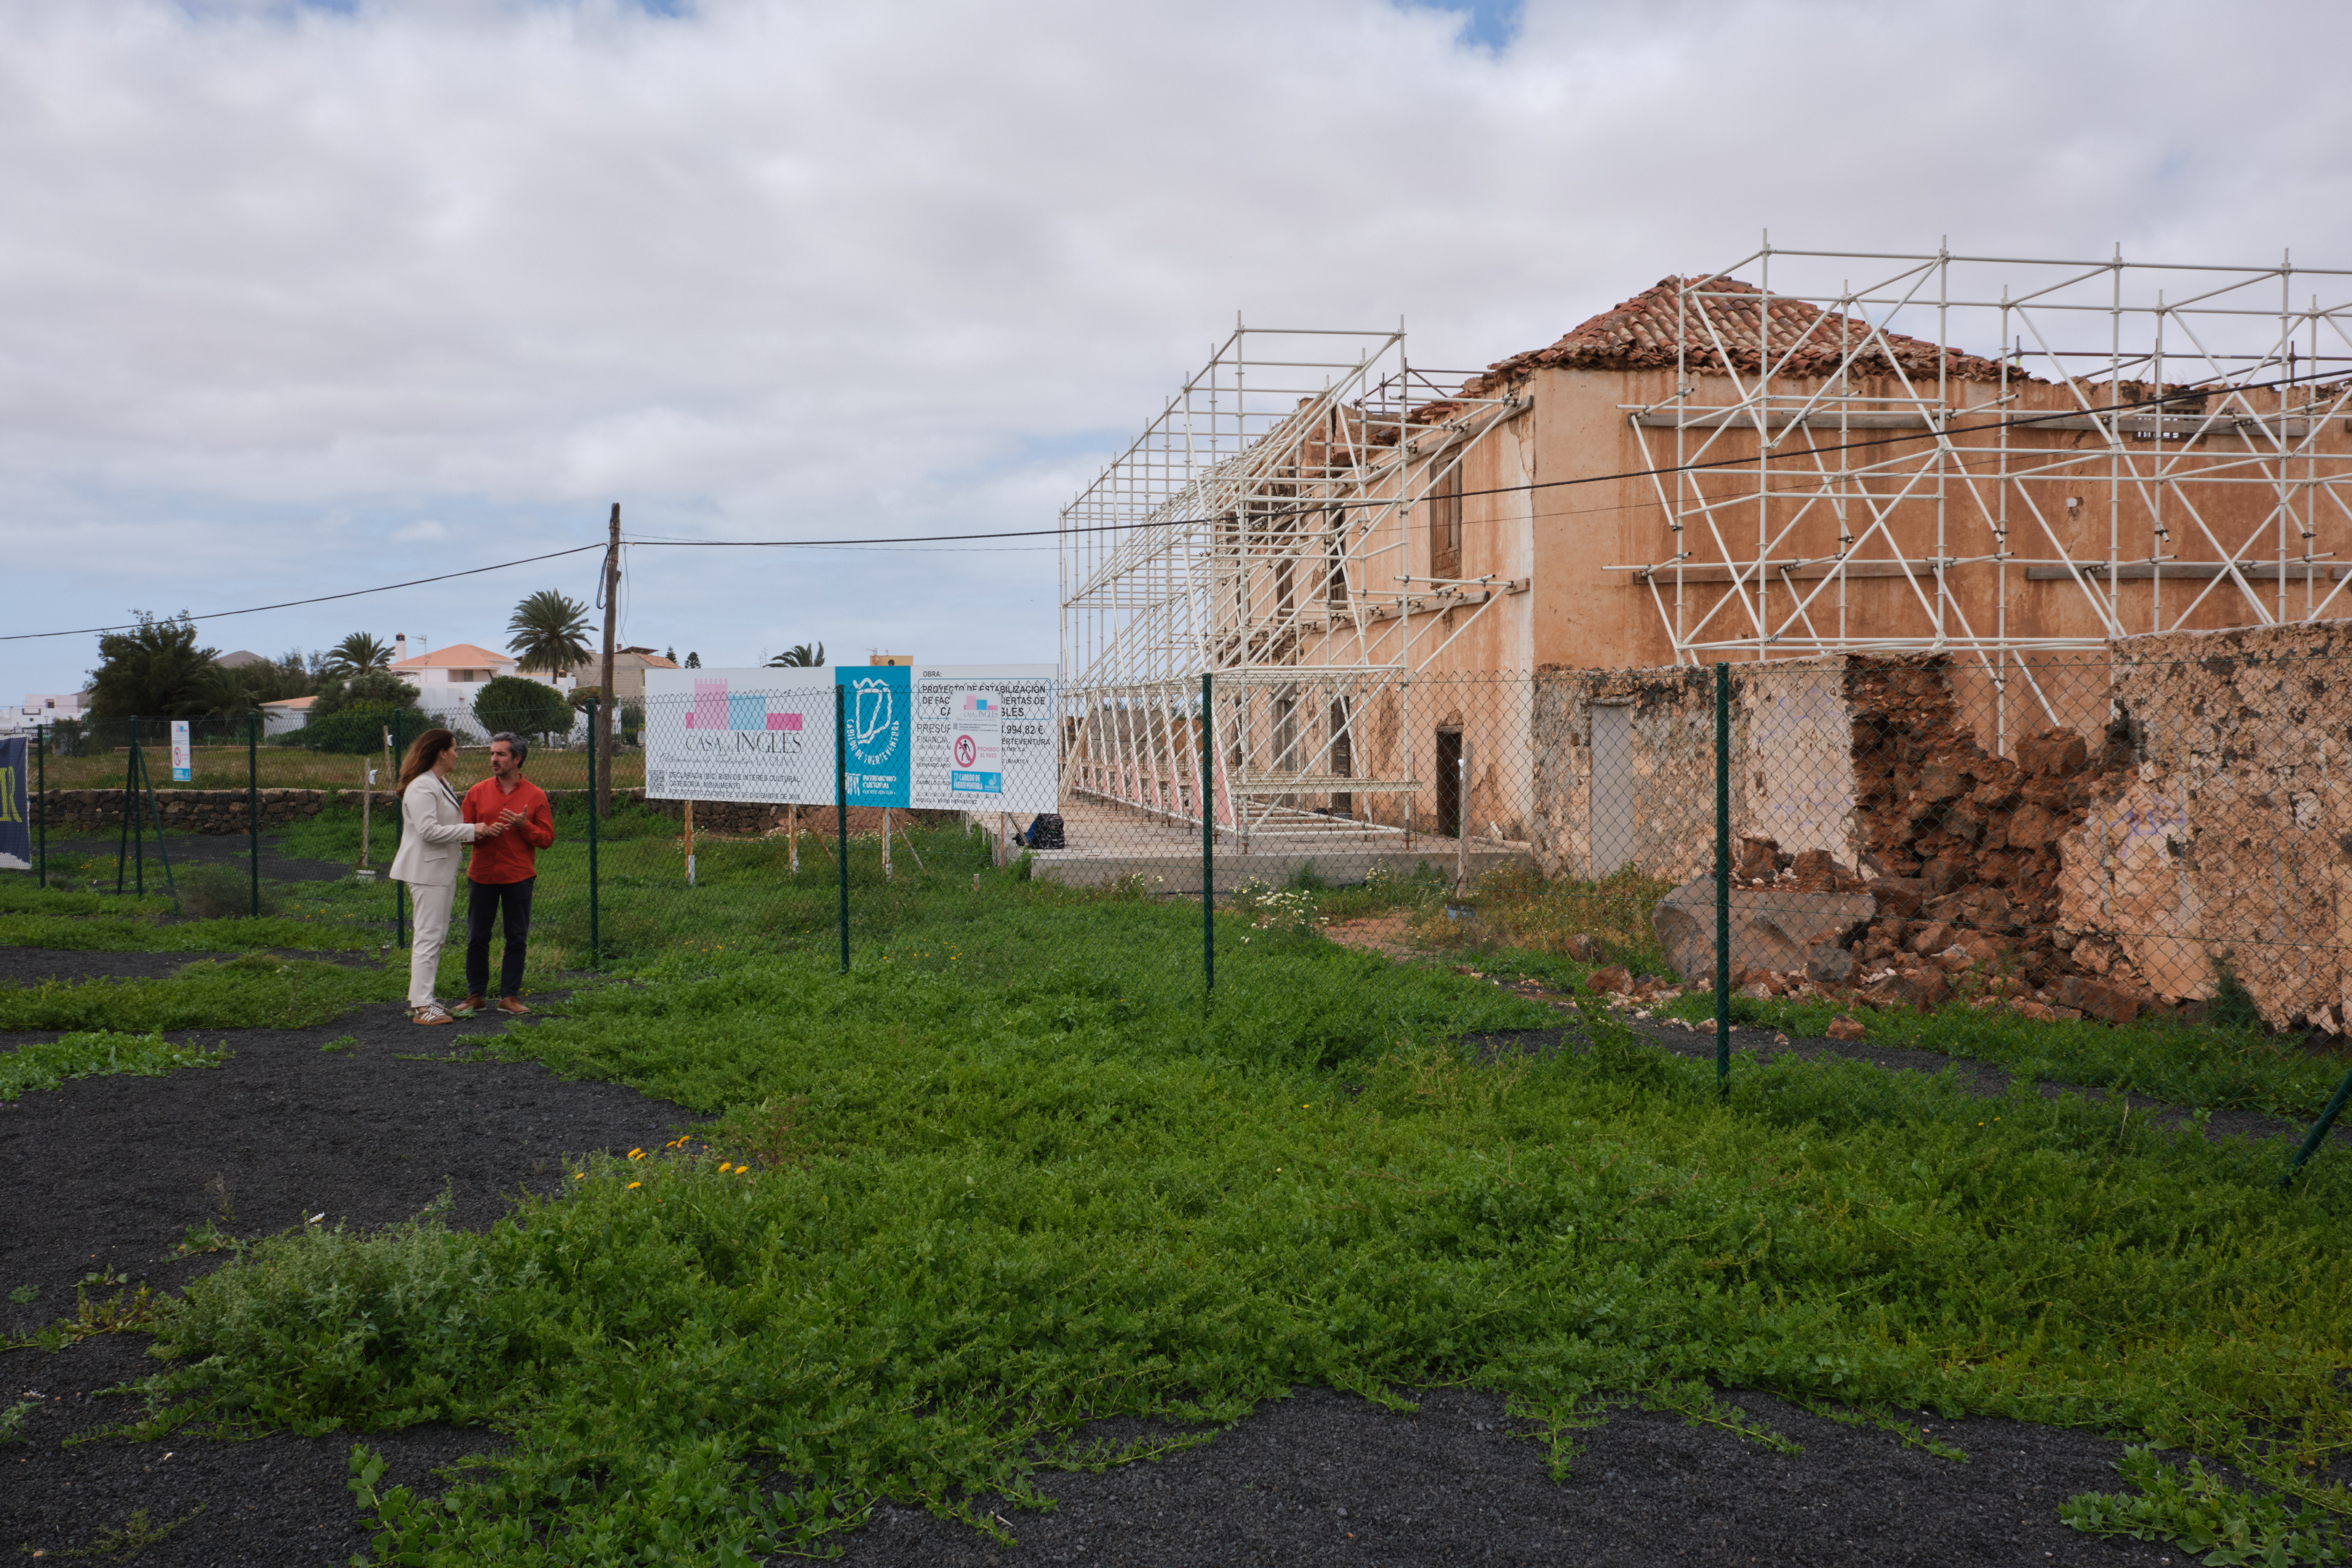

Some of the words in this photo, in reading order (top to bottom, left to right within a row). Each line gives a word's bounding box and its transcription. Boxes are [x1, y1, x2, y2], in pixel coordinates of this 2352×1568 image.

[1038, 725, 1043, 735] €
[685, 735, 722, 752] CASA
[847, 719, 858, 751] CABILDO
[855, 749, 864, 760] DE
[864, 720, 899, 765] FUERTEVENTURA
[953, 781, 983, 790] FUERTEVENTURA
